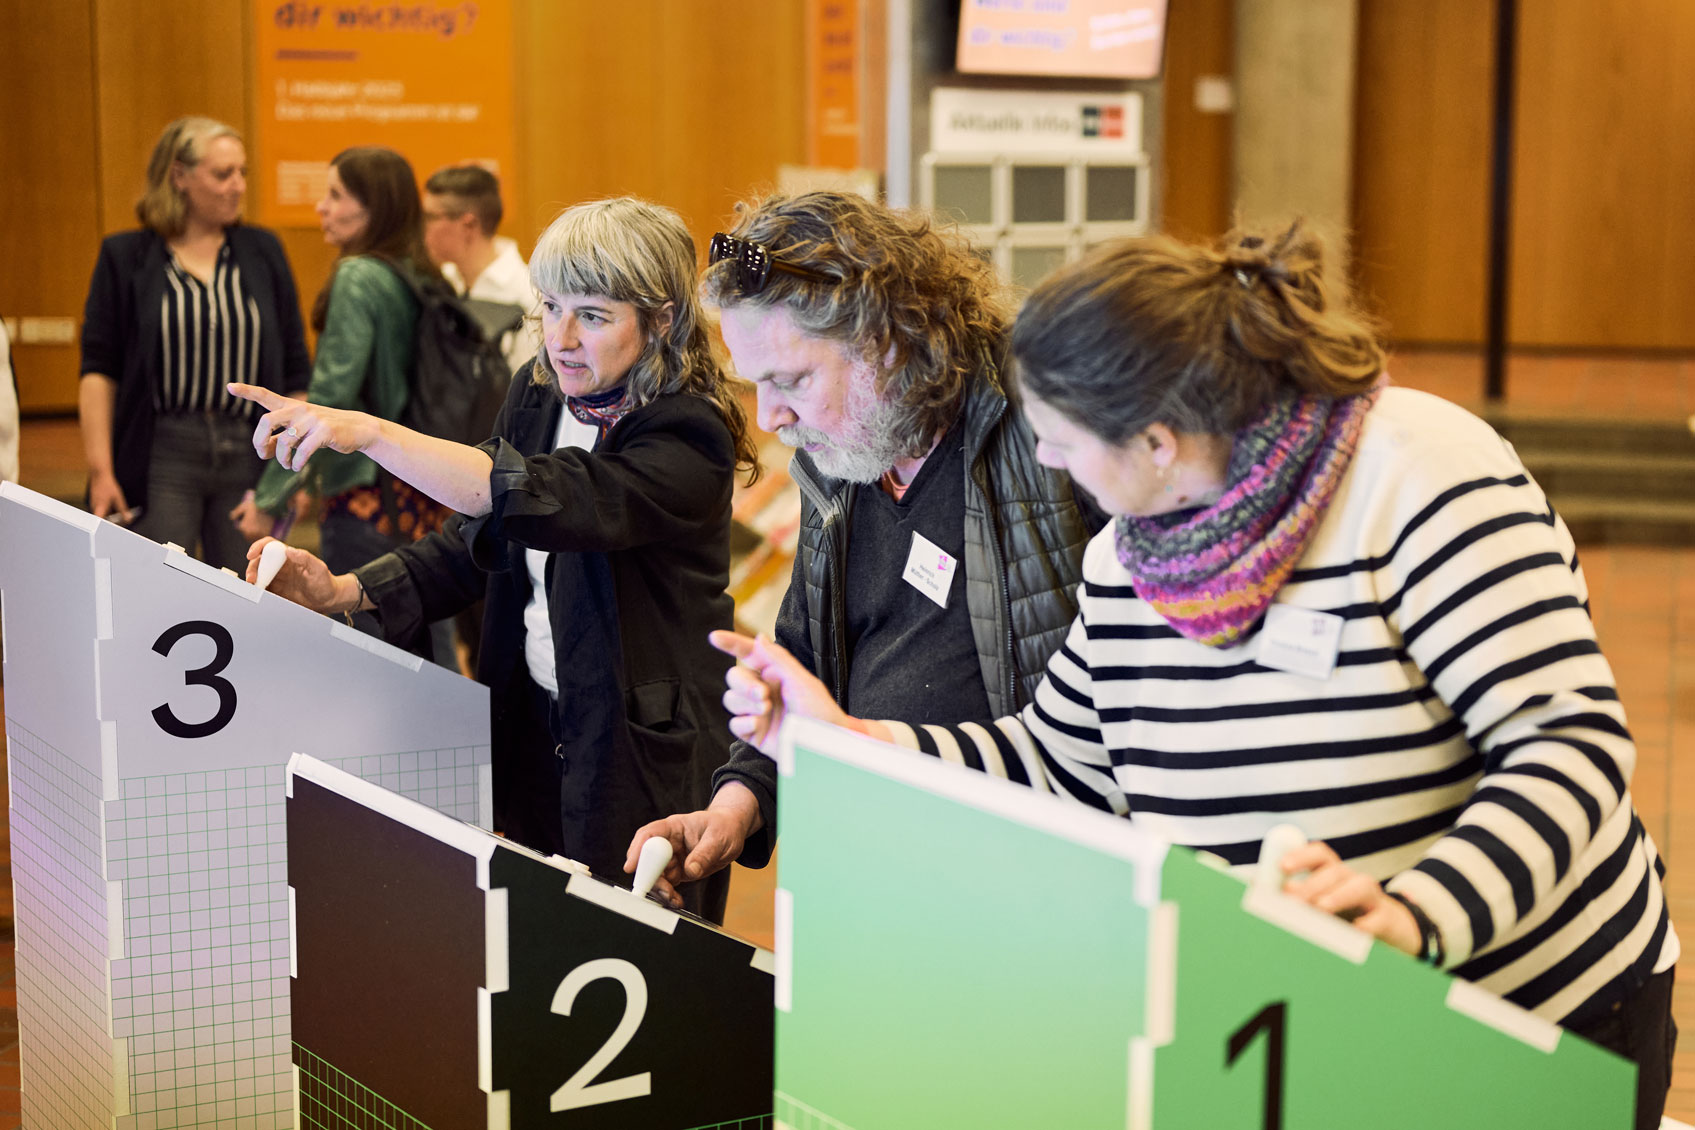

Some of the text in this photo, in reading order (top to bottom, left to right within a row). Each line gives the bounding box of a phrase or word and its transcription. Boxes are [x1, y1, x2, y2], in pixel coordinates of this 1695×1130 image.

[275, 2, 479, 39] dir wichtig?
[151, 620, 237, 738] 3
[550, 958, 651, 1113] 2
[1225, 1001, 1288, 1130] 1
